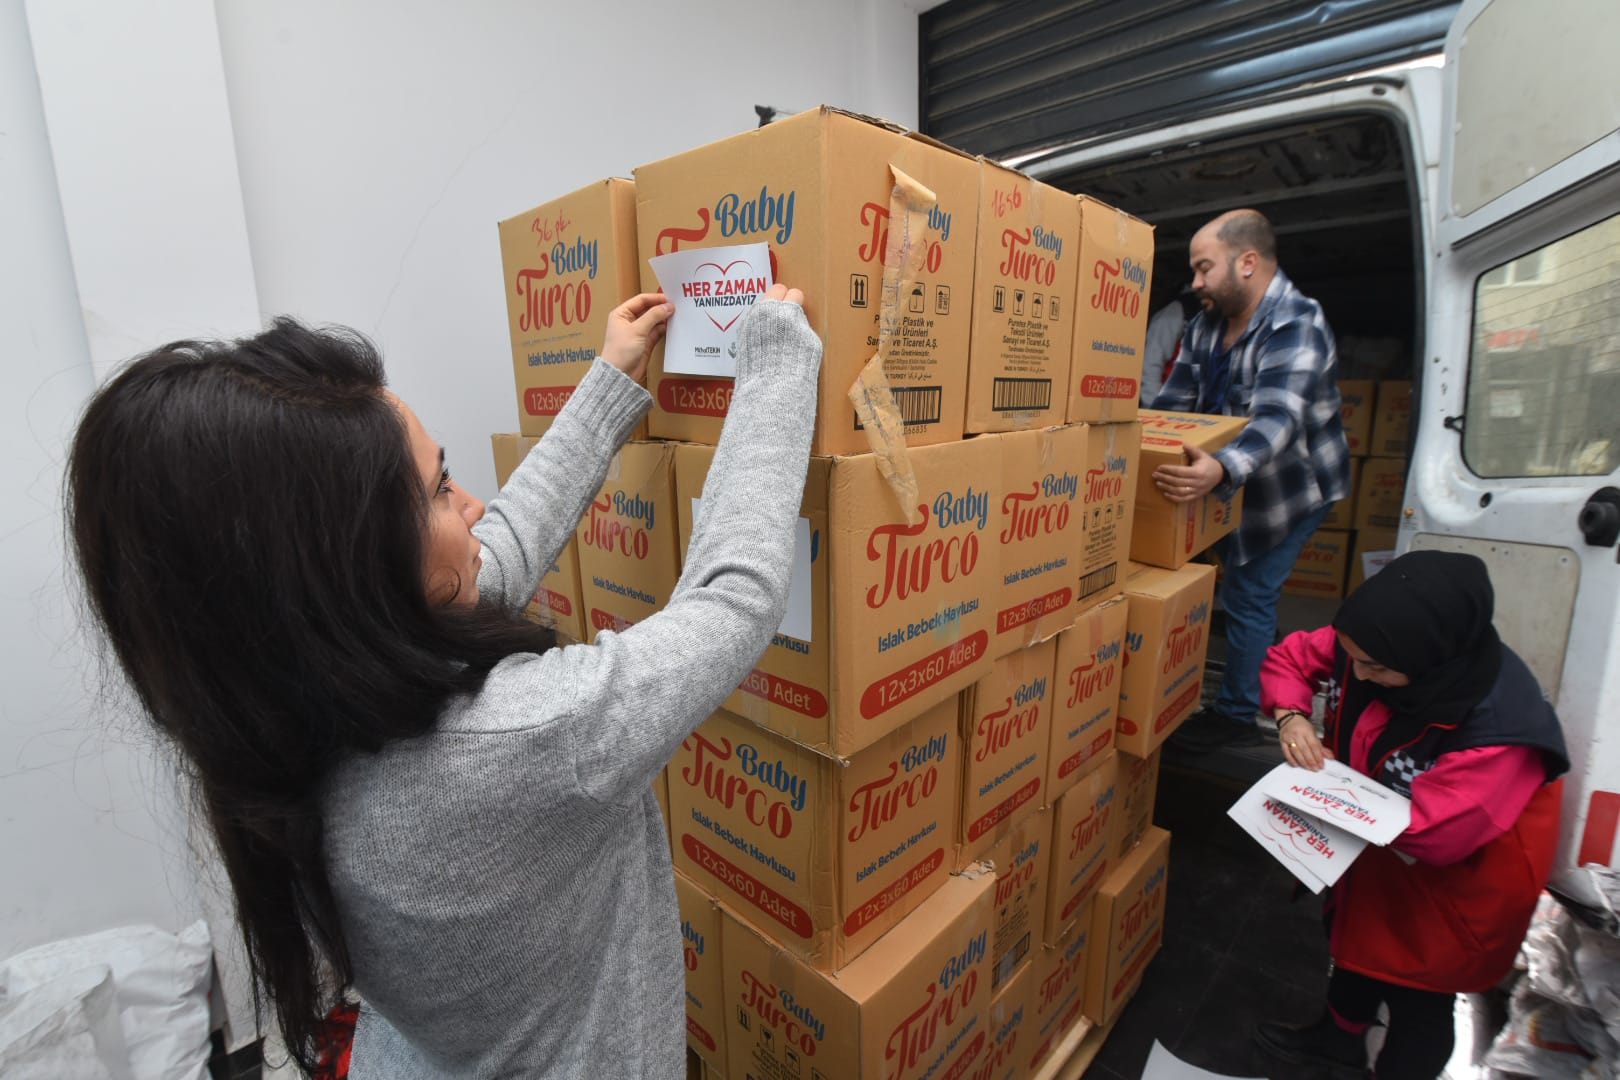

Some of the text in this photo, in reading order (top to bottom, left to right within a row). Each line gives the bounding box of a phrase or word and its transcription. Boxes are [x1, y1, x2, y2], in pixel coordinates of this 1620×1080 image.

[714, 185, 796, 245] Baby
[1033, 224, 1063, 261] Baby
[551, 235, 598, 280] Baby
[1000, 227, 1056, 287] Turco
[1122, 256, 1147, 292] Baby
[516, 252, 591, 332] Turco
[682, 276, 767, 298] HER ZAMAN
[1091, 257, 1140, 319] Turco
[902, 327, 929, 338] Ürünleri
[903, 316, 934, 328] Plastik ve
[903, 337, 925, 348] Ticaret
[527, 347, 596, 367] Islak Bebek Havlusu
[613, 489, 655, 530] Baby
[933, 486, 989, 531] Baby
[1042, 471, 1079, 501] Baby
[1084, 462, 1122, 505] Turco
[583, 493, 649, 560] Turco
[1000, 480, 1070, 545] Turco
[866, 503, 979, 609] Turco
[1004, 569, 1020, 585] Islak
[1021, 563, 1042, 581] Bebek
[878, 598, 979, 653] Islak Bebek Havlusu
[1001, 593, 1064, 628] 12x3x60 Adet
[772, 633, 810, 655] avlusu
[774, 682, 811, 711] Adet
[879, 640, 977, 707] 12x3x60 Adet
[1014, 676, 1046, 708] Baby
[1067, 653, 1115, 709] Turco
[901, 732, 947, 773] Baby
[976, 696, 1039, 762] Turco
[682, 731, 793, 839] Turco
[736, 744, 807, 812] Baby
[848, 761, 938, 843] Turco
[1291, 785, 1345, 809] ZAMAN
[1263, 799, 1335, 860] HER ZAMAN
[1345, 807, 1377, 825] HER
[692, 808, 796, 882] Islak Bebek Havlusu
[856, 821, 937, 883] Islak Bebek Havlusu
[694, 844, 798, 928] 12x3x60 Adet
[857, 858, 935, 926] 12x3x60 Adet
[939, 928, 987, 990] Baby
[741, 970, 816, 1057] Turco
[779, 990, 825, 1041] Baby
[885, 969, 978, 1080] Turco
